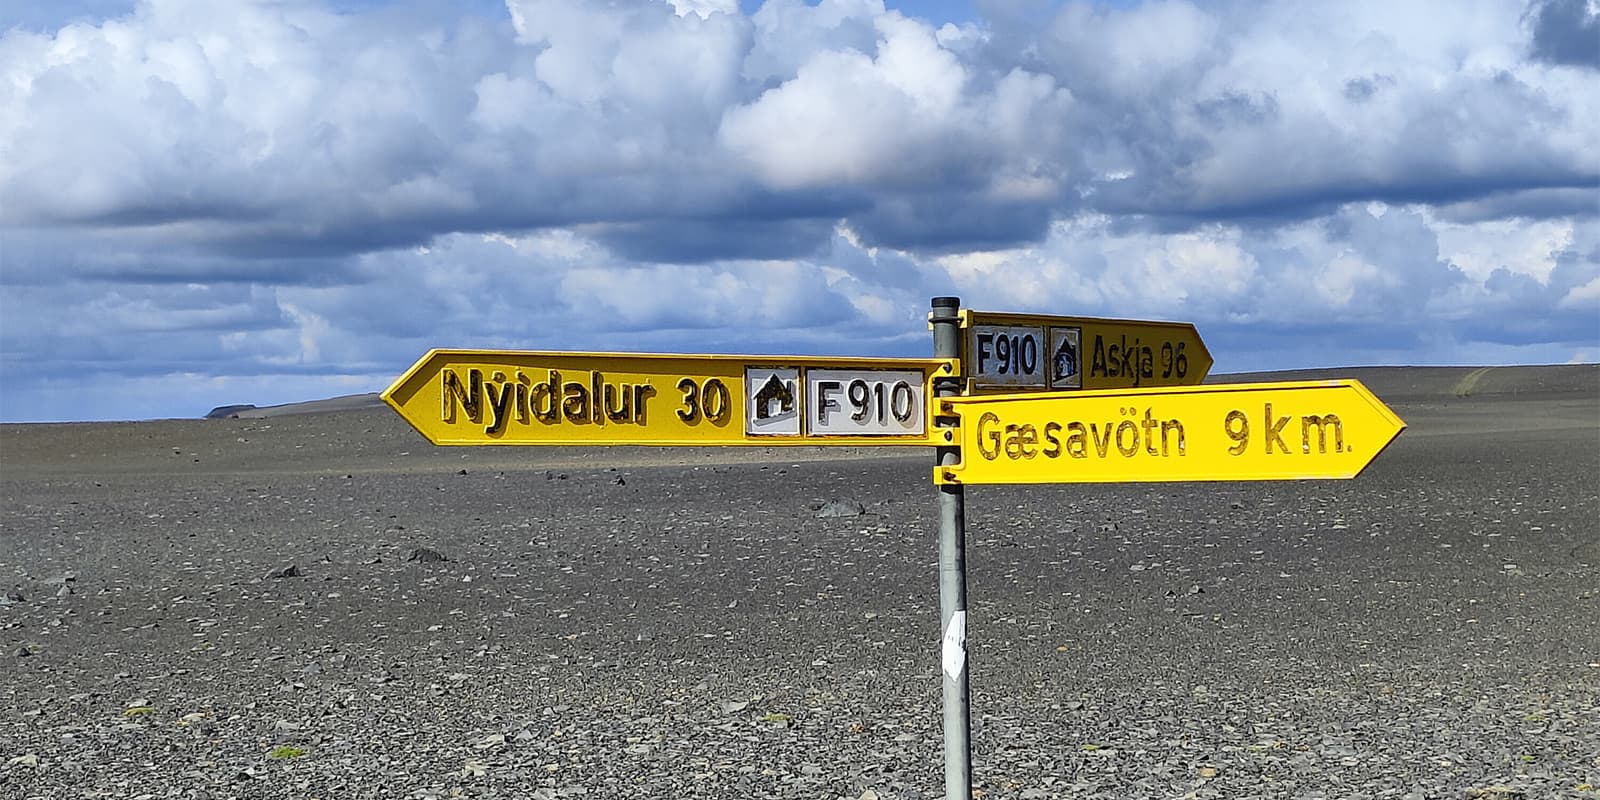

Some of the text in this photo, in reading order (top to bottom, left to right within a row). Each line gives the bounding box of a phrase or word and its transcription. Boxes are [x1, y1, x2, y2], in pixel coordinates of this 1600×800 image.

[977, 333, 1188, 387] F910 Askja 96
[676, 377, 730, 425] 30
[818, 379, 916, 426] F910
[977, 402, 1353, 460] Gæsavötn 9 km.
